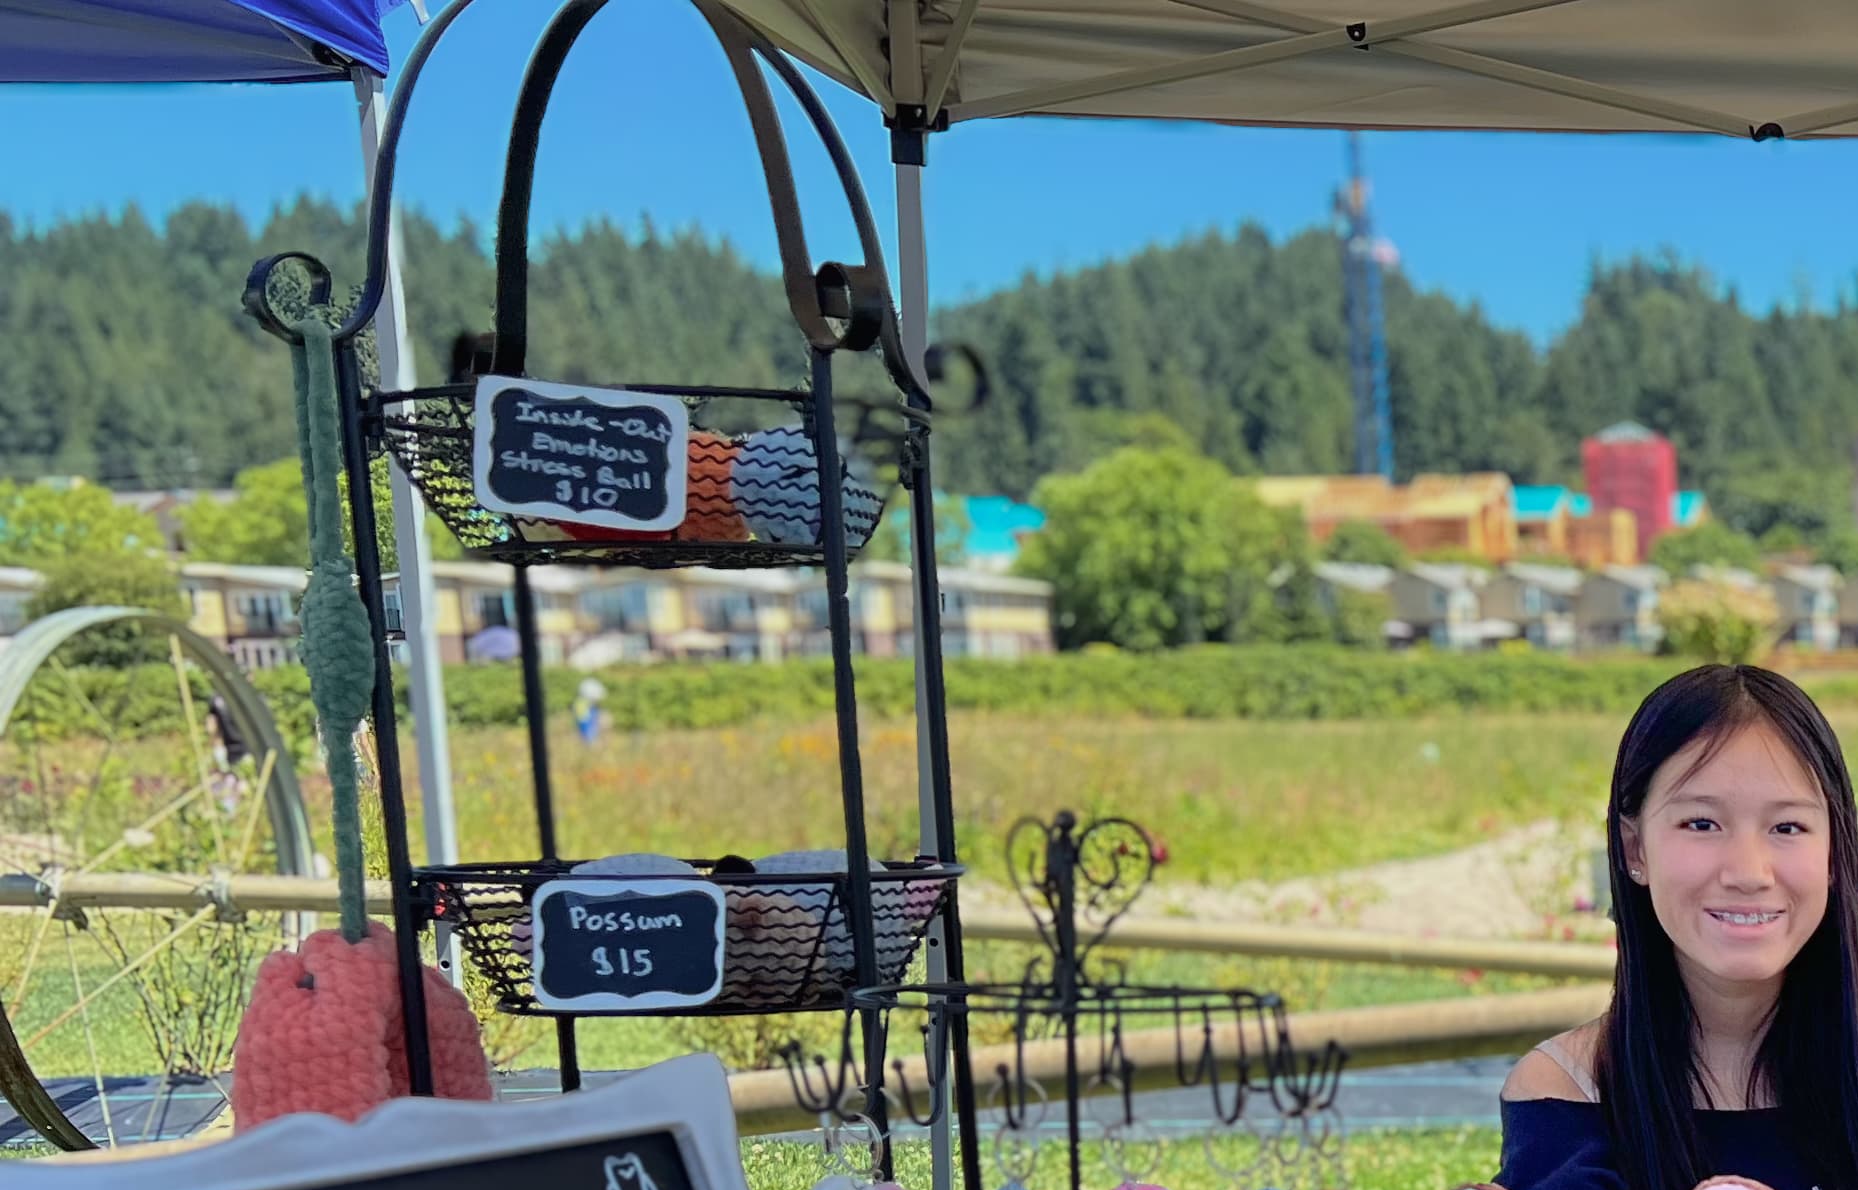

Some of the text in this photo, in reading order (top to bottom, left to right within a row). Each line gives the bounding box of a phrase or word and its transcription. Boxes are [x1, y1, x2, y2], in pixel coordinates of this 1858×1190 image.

[532, 432, 648, 464] Emotions
[500, 451, 652, 490] Stress Ball
[555, 480, 619, 506] $10
[568, 906, 683, 931] Possum
[591, 947, 653, 977] $15
